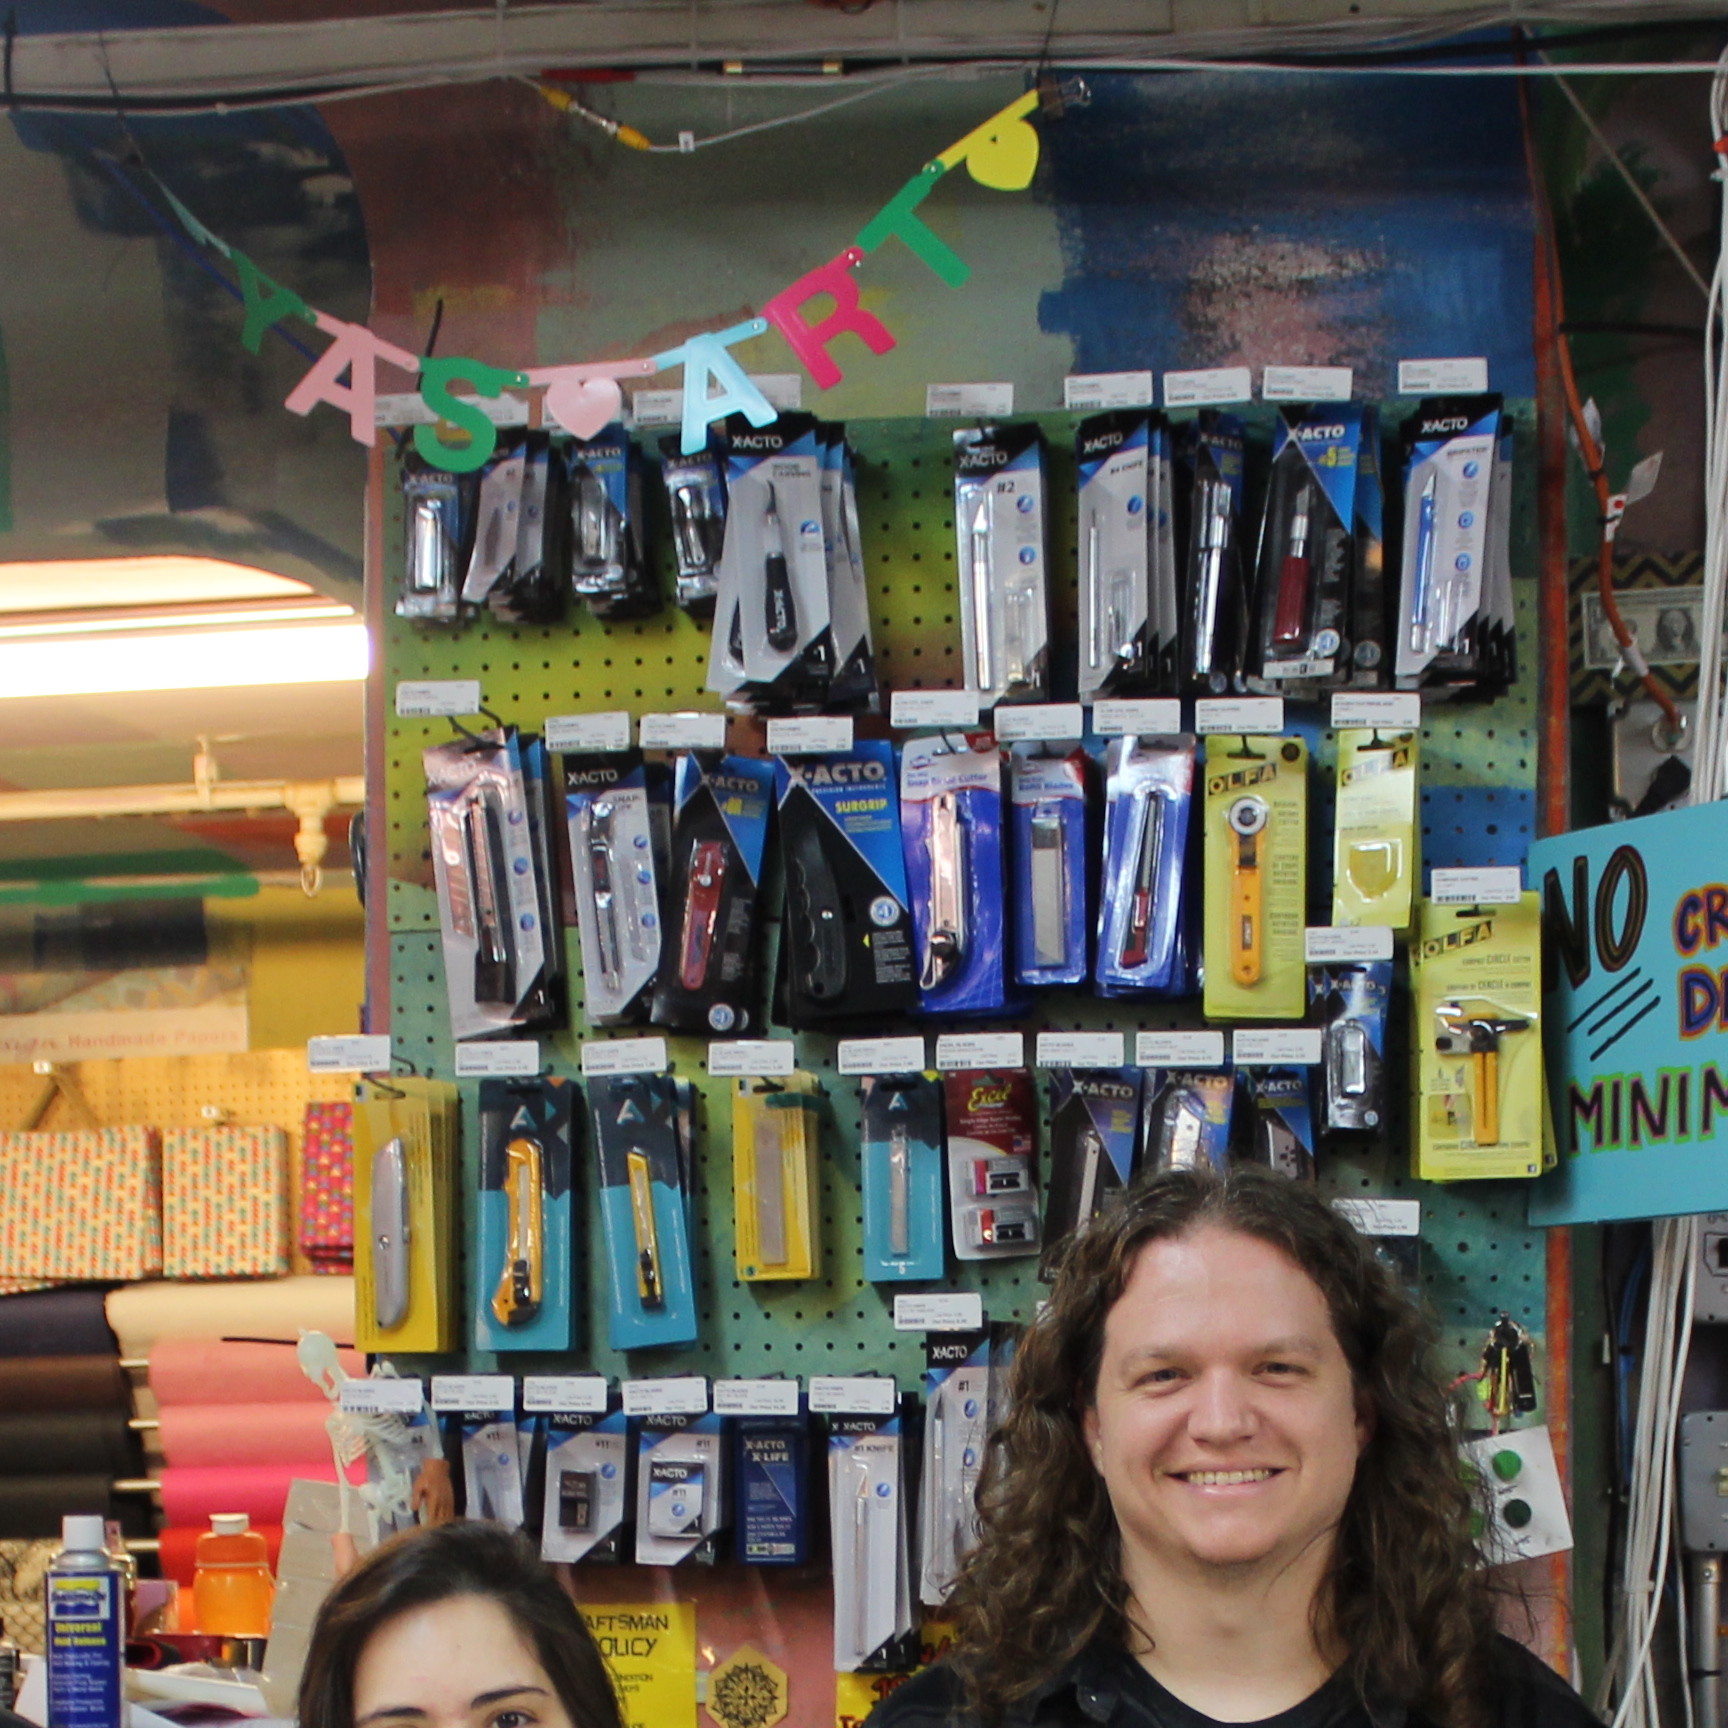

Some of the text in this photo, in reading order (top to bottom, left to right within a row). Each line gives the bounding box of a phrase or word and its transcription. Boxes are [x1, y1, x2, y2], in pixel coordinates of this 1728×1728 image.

[662, 160, 971, 456] ART
[1284, 424, 1346, 441] X-ACTO
[1421, 417, 1468, 433] X-ACTO
[732, 434, 783, 449] X-ACTO
[1084, 433, 1122, 453] X-ACTO
[959, 451, 1007, 468] X-ACTO
[997, 481, 1015, 494] #2
[788, 759, 887, 786] X-ACTO
[1341, 748, 1410, 787] OLFA
[568, 770, 618, 785] X-ACTO
[1208, 762, 1278, 796] OLFA
[835, 798, 889, 814] SURGRIP
[1542, 844, 1649, 993] NO
[1424, 920, 1492, 958] OLFA
[1167, 1071, 1229, 1090] X-ACTO
[1255, 1080, 1302, 1093] X-ACTO
[1072, 1081, 1134, 1098] X-ACTO
[968, 1085, 1012, 1111] Excel
[932, 1346, 968, 1359] X-ACTO
[958, 1380, 970, 1392] #1
[553, 1414, 592, 1426] X-ACTO
[646, 1415, 687, 1427] X-ACTO
[843, 1421, 877, 1432] X-ACTO
[745, 1439, 786, 1451] X-ACTO
[652, 1467, 687, 1479] X-ACTO
[585, 1614, 669, 1633] AFTSMAN
